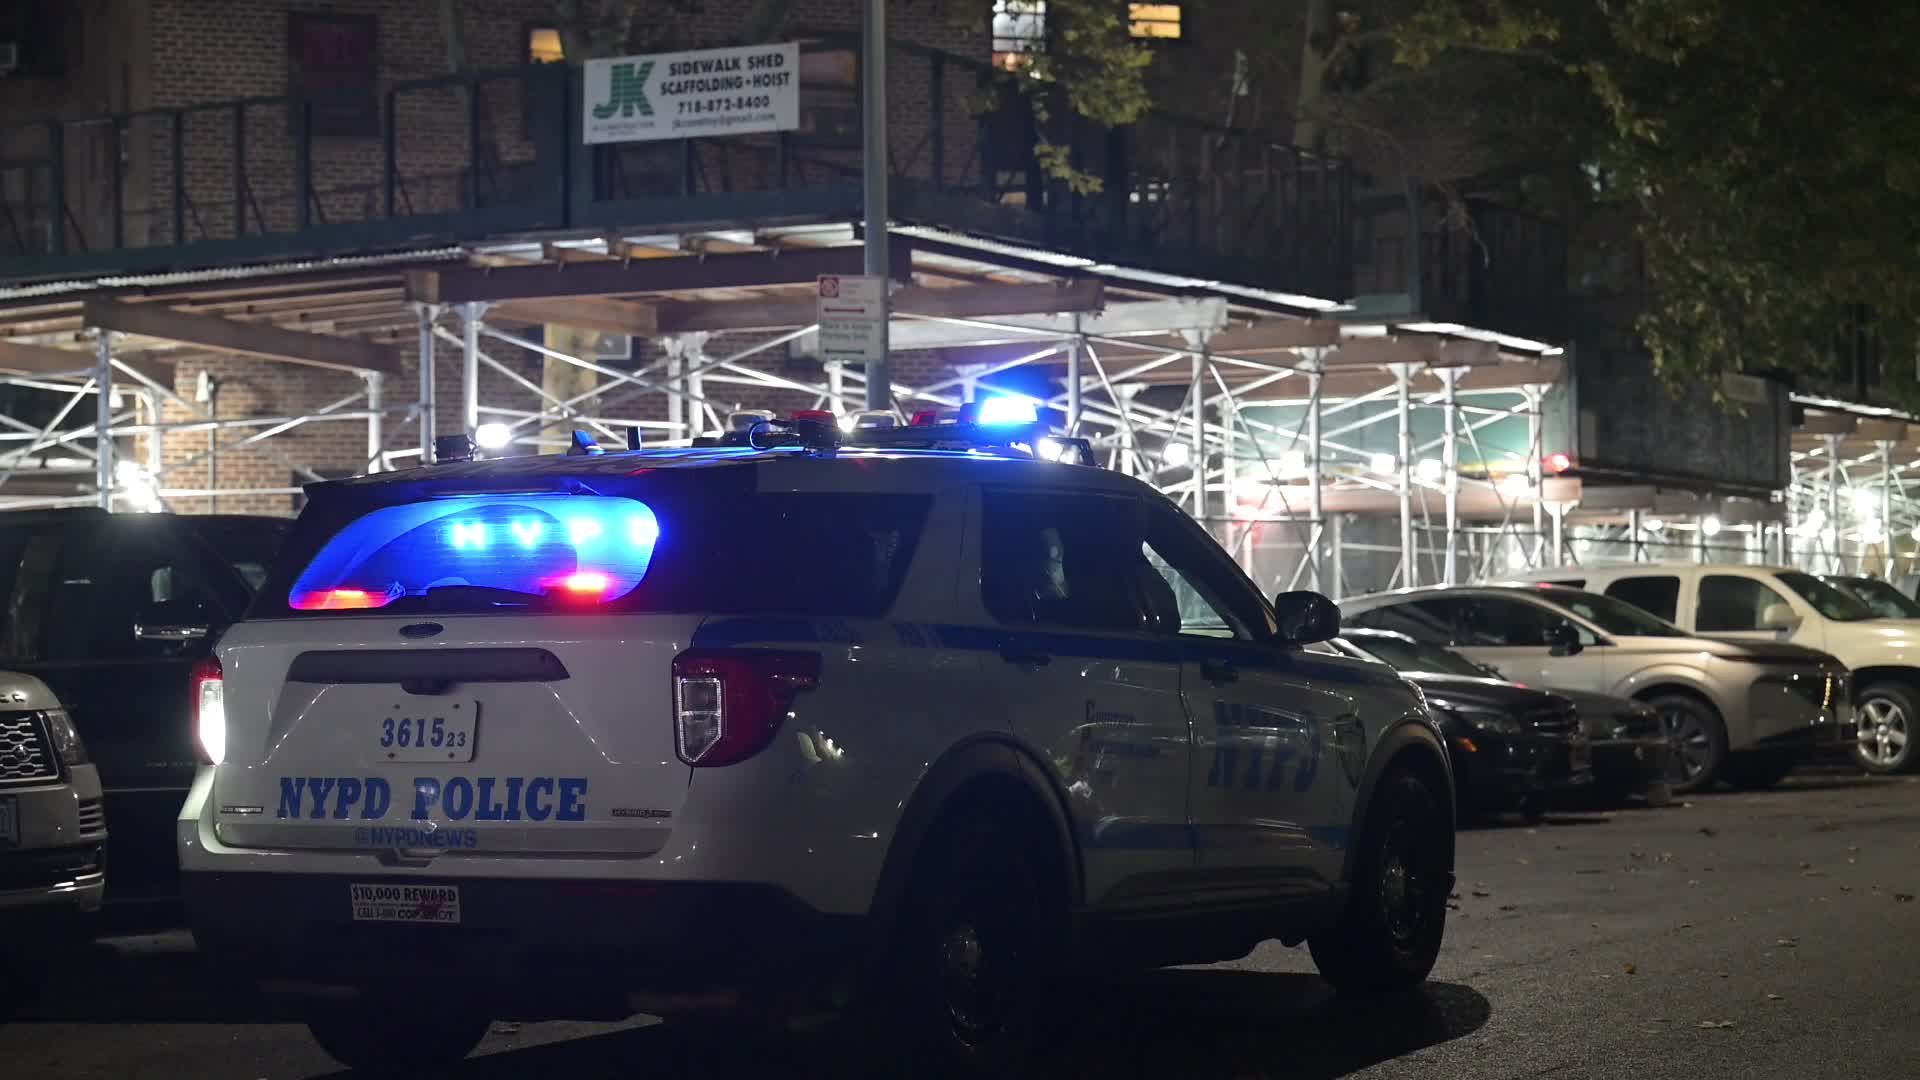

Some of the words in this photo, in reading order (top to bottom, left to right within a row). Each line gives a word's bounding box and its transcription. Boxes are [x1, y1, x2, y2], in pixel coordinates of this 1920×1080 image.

[669, 56, 741, 76] SIDEWALK
[747, 53, 784, 70] SHED
[592, 61, 655, 119] JK
[380, 717, 445, 747] 3615
[277, 777, 391, 820] NYPD
[411, 777, 588, 821] POLICE
[353, 827, 478, 849] @NYPDNEWS
[352, 886, 400, 902] $10,000
[404, 887, 457, 903] REWARD
